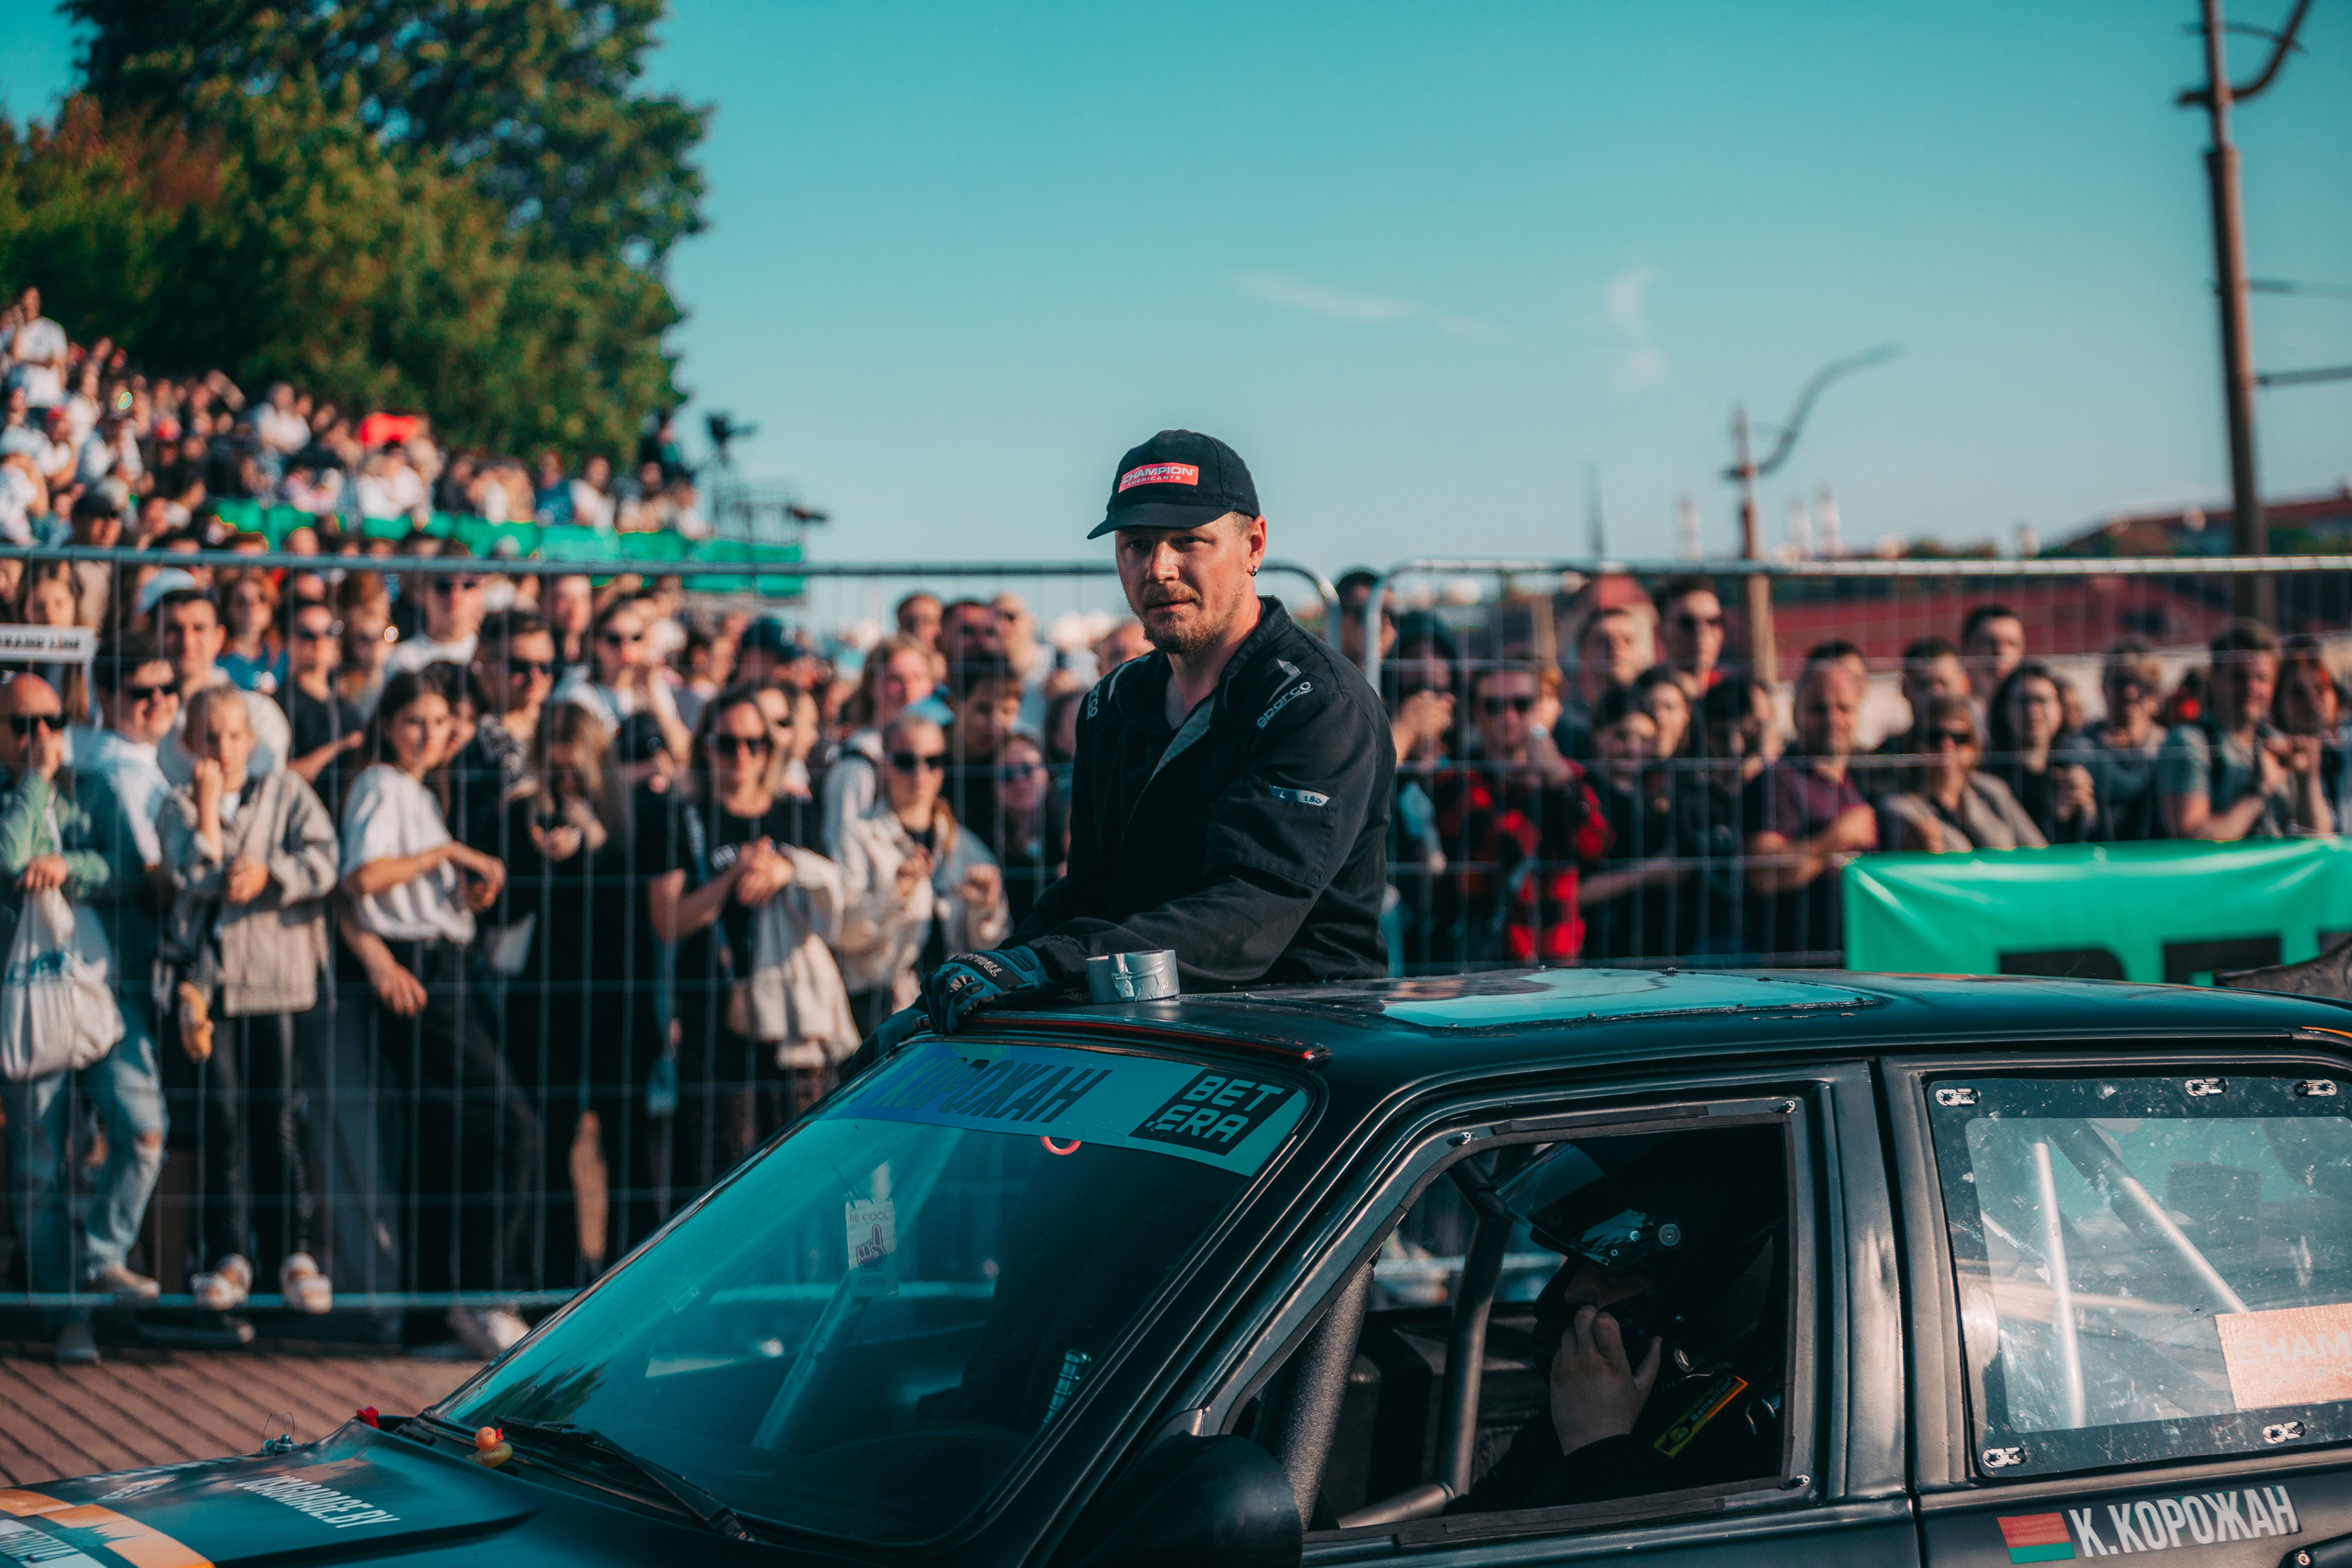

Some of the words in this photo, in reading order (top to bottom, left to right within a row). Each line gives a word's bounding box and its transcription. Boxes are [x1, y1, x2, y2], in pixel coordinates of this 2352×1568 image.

[1123, 467, 1193, 484] CHAMPION
[1127, 475, 1182, 486] LUBRICANTS
[1303, 795, 1322, 805] 180
[871, 1056, 1113, 1123] КОРОЖАН
[1182, 1075, 1284, 1112] BET
[849, 1213, 859, 1222] BE
[863, 1212, 888, 1221] COOL
[2234, 1331, 2352, 1366] CHAM
[2068, 1484, 2299, 1557] К.КОРОЖАН
